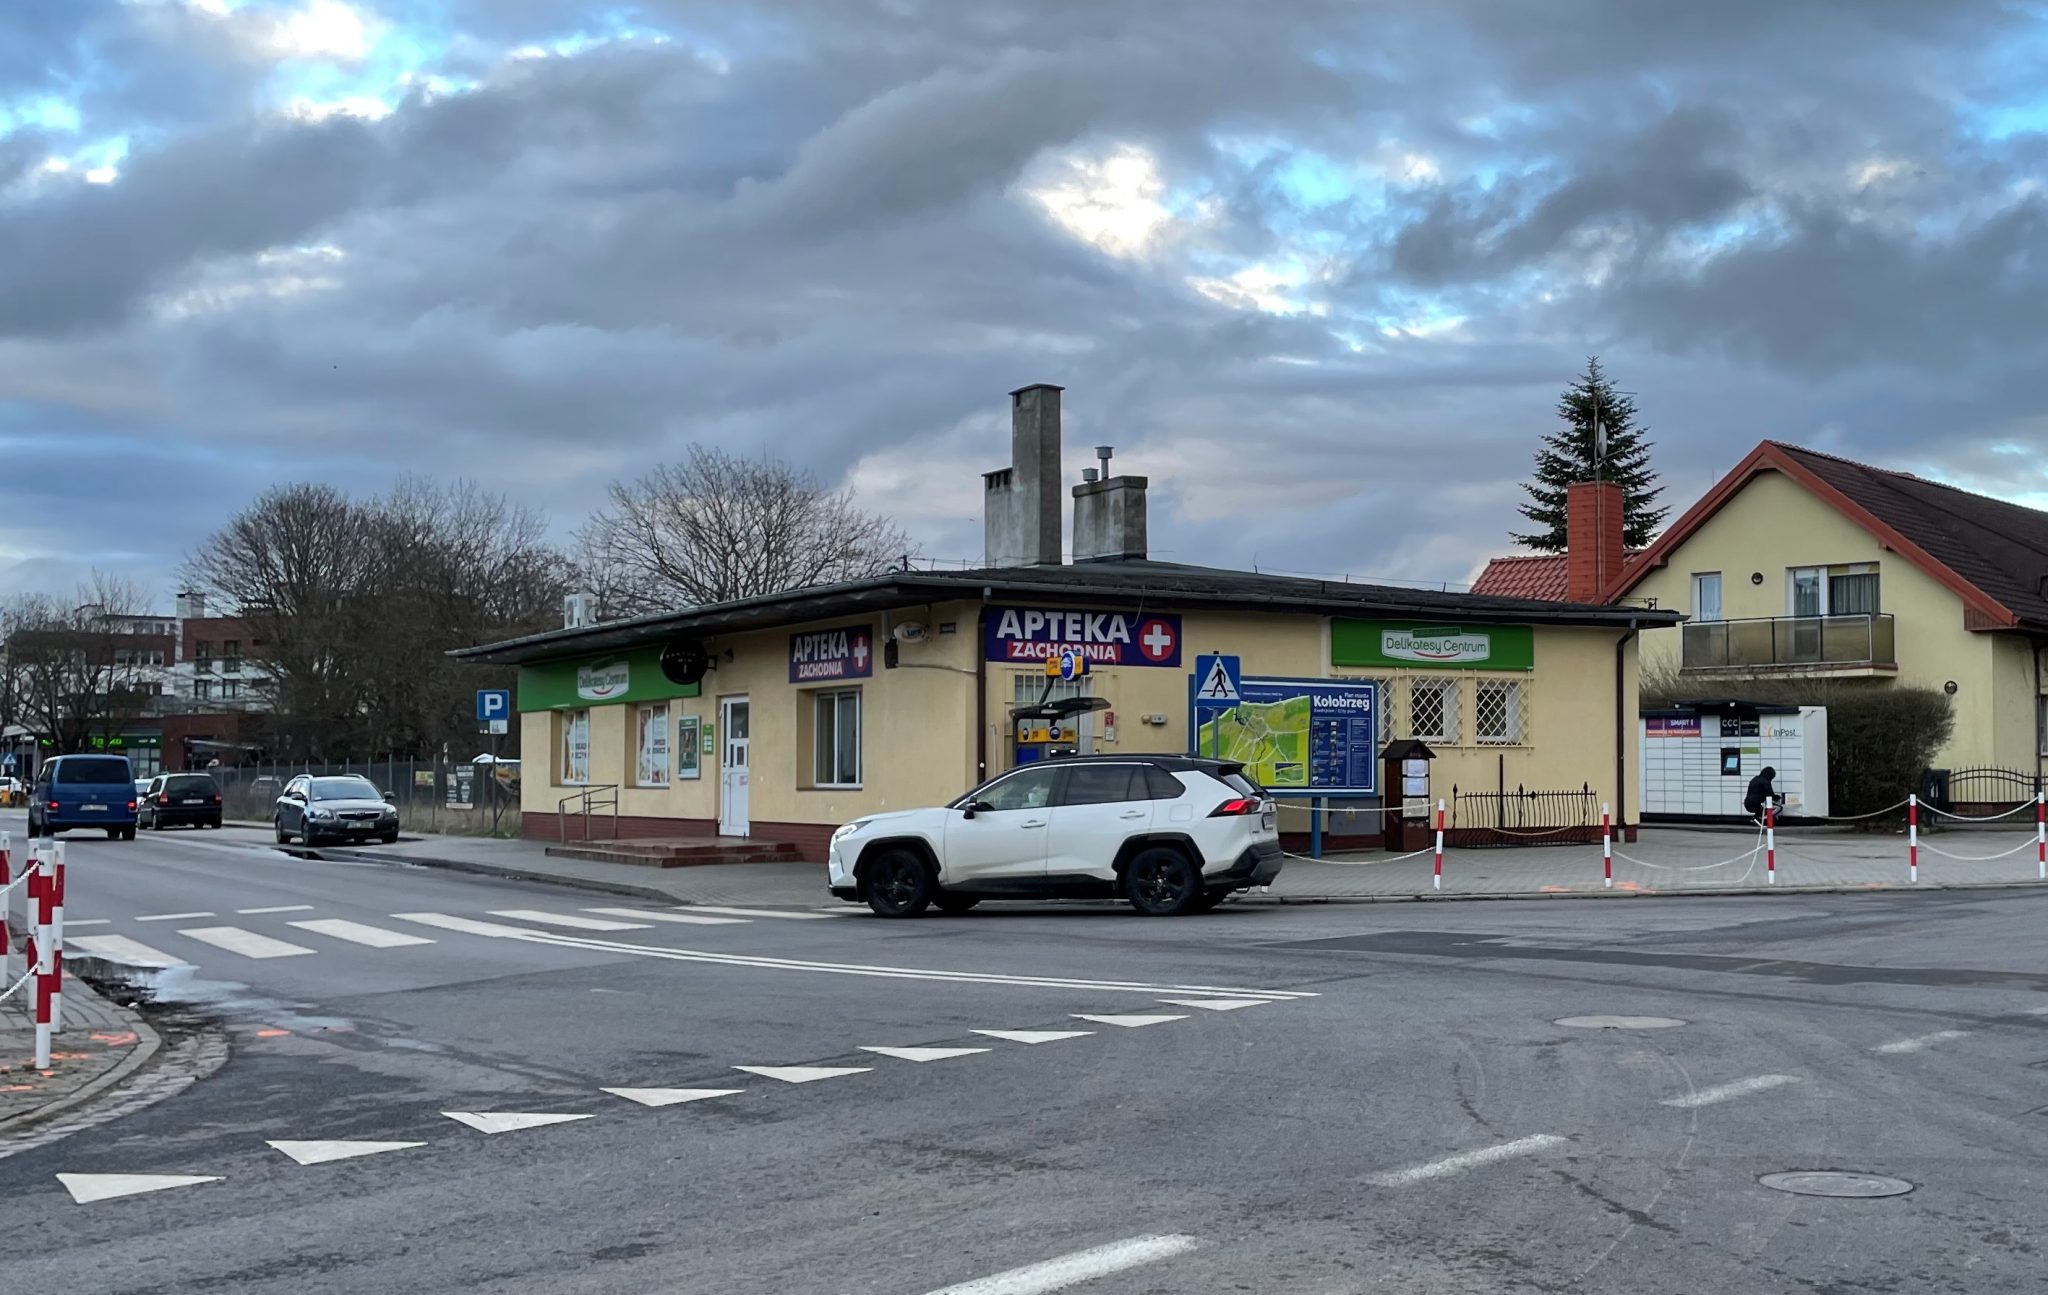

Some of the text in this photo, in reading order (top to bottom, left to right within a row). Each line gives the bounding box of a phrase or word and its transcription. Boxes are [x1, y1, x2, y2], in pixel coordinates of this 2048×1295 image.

[996, 609, 1131, 644] APTEKA
[793, 631, 849, 663] APTEKA
[1386, 637, 1487, 654] Delikatesy Centrum
[798, 661, 843, 678] ZACHODNIA
[484, 693, 503, 717] P
[1313, 694, 1370, 711] Kołobrzeg
[1721, 719, 1738, 727] CCC
[1773, 728, 1796, 737] InPost
